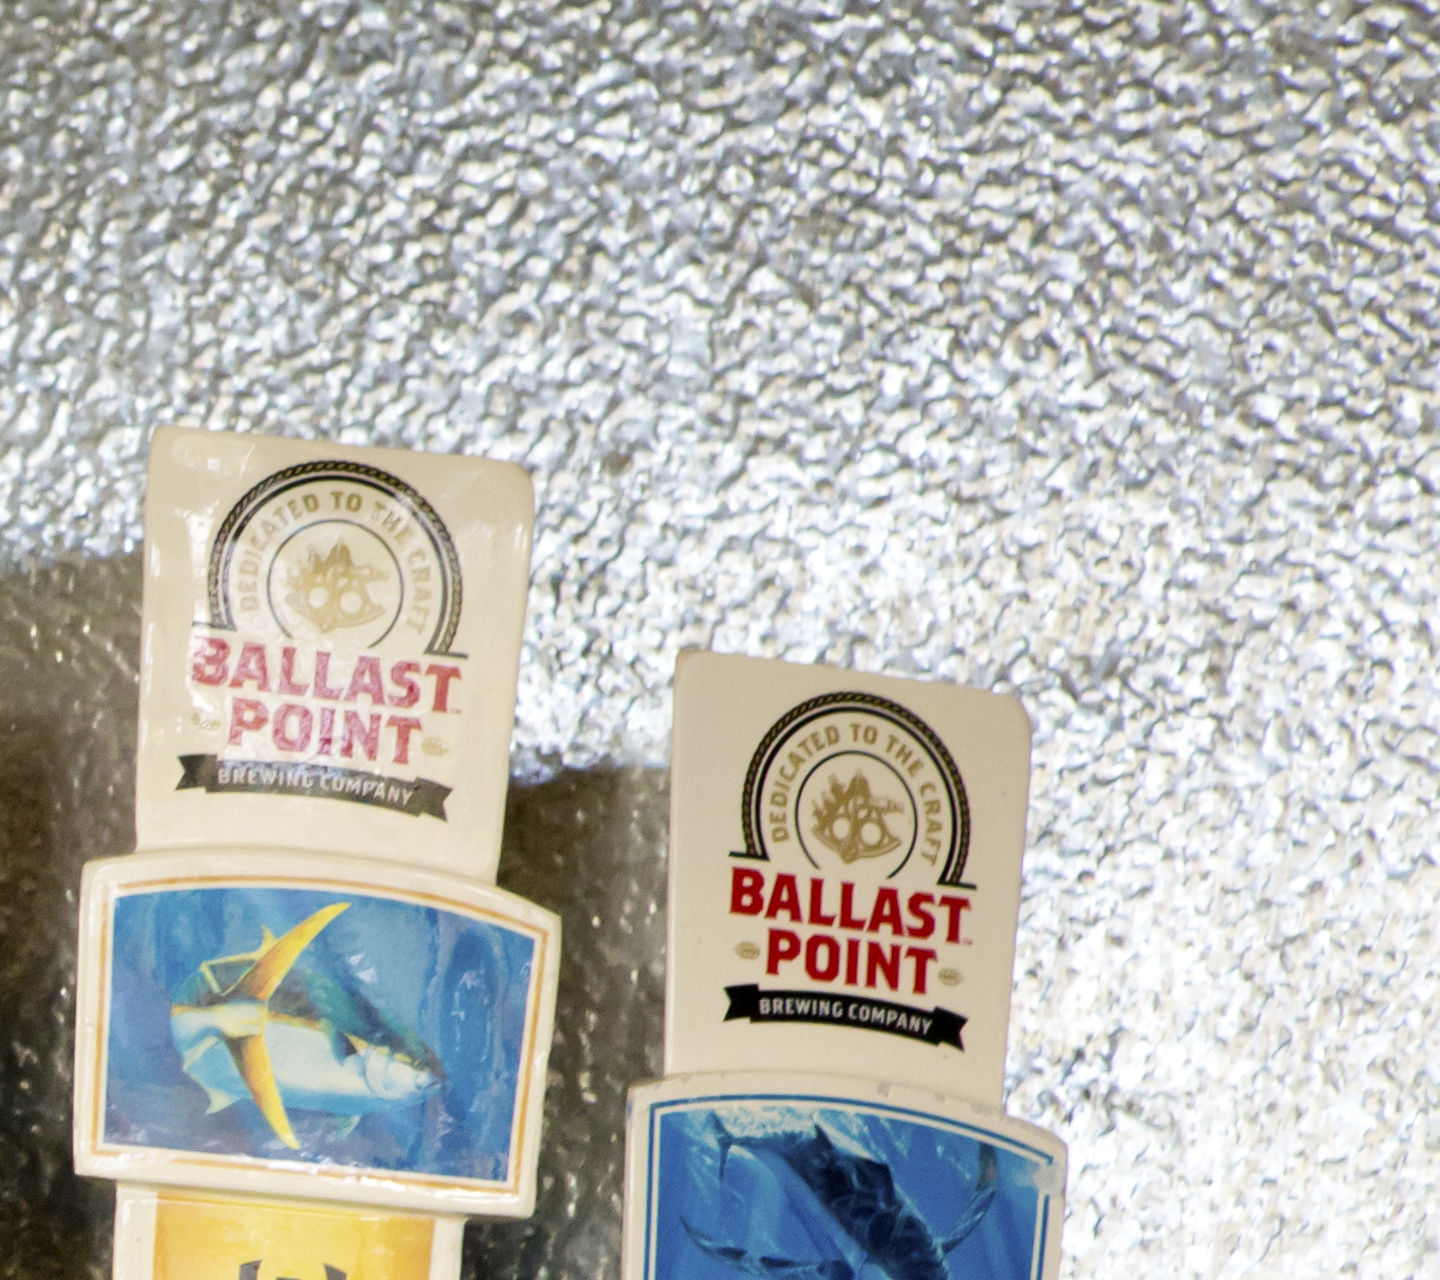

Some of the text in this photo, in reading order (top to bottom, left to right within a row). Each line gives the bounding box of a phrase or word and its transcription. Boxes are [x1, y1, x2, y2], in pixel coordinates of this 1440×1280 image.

[192, 636, 462, 714] BALLAST
[229, 698, 423, 765] POINT
[320, 772, 414, 806] COMPANY
[770, 723, 942, 866] DEDICATED TO THE CRAFT
[730, 867, 972, 945] BALLAST
[766, 927, 938, 995] POINT
[759, 998, 933, 1035] BREWING COMPANY
